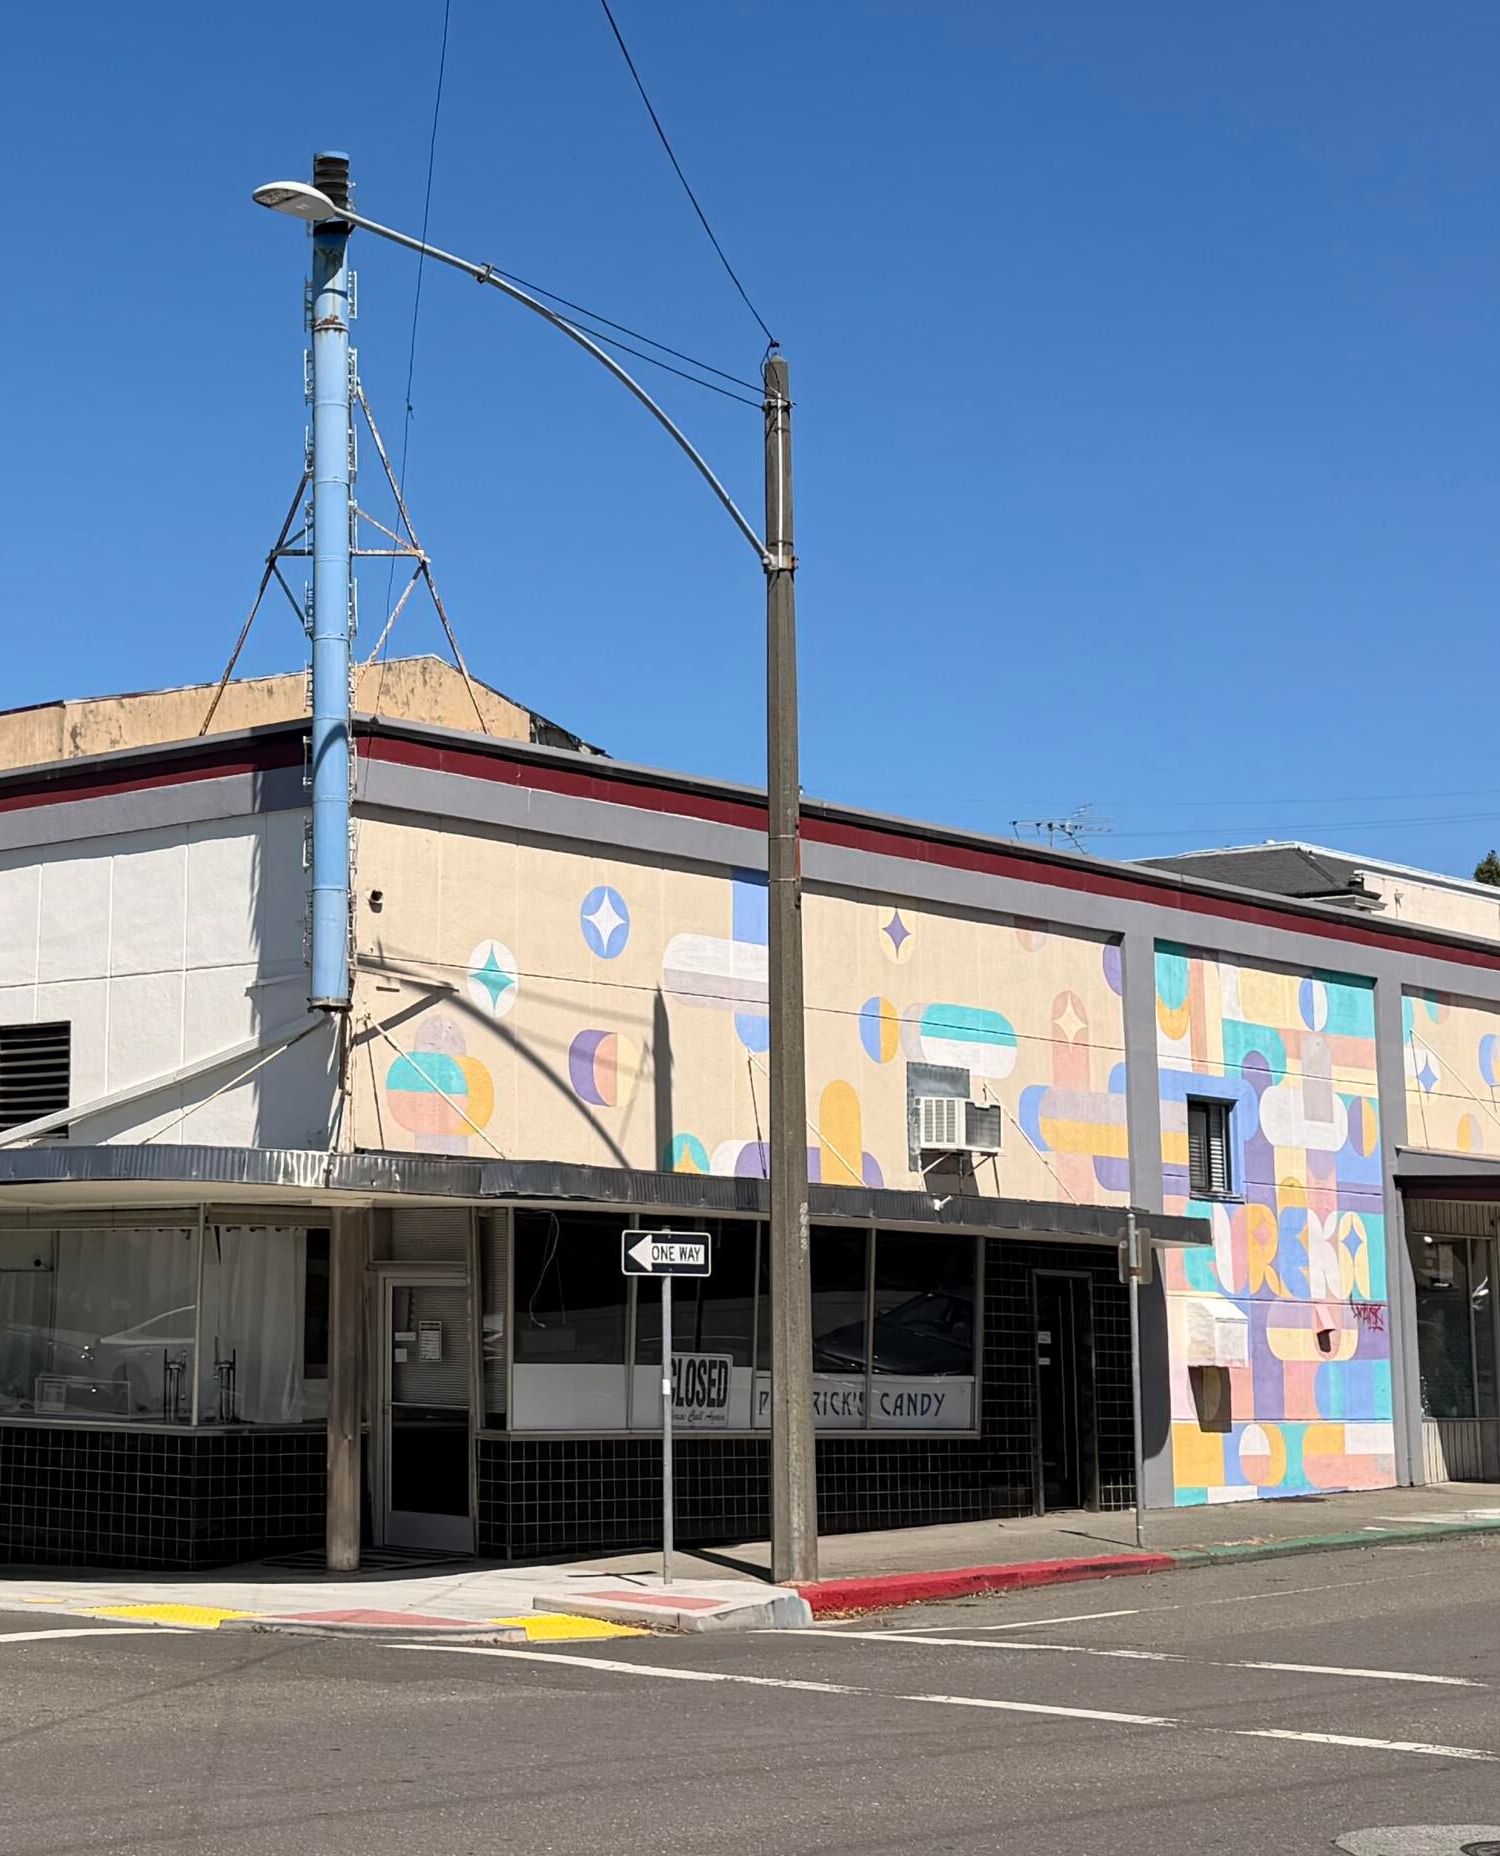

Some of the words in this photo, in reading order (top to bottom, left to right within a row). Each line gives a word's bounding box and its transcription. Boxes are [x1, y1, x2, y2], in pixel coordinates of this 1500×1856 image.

[651, 1245, 676, 1262] ONE
[679, 1246, 702, 1262] WAY
[880, 1392, 946, 1417] CANDY
